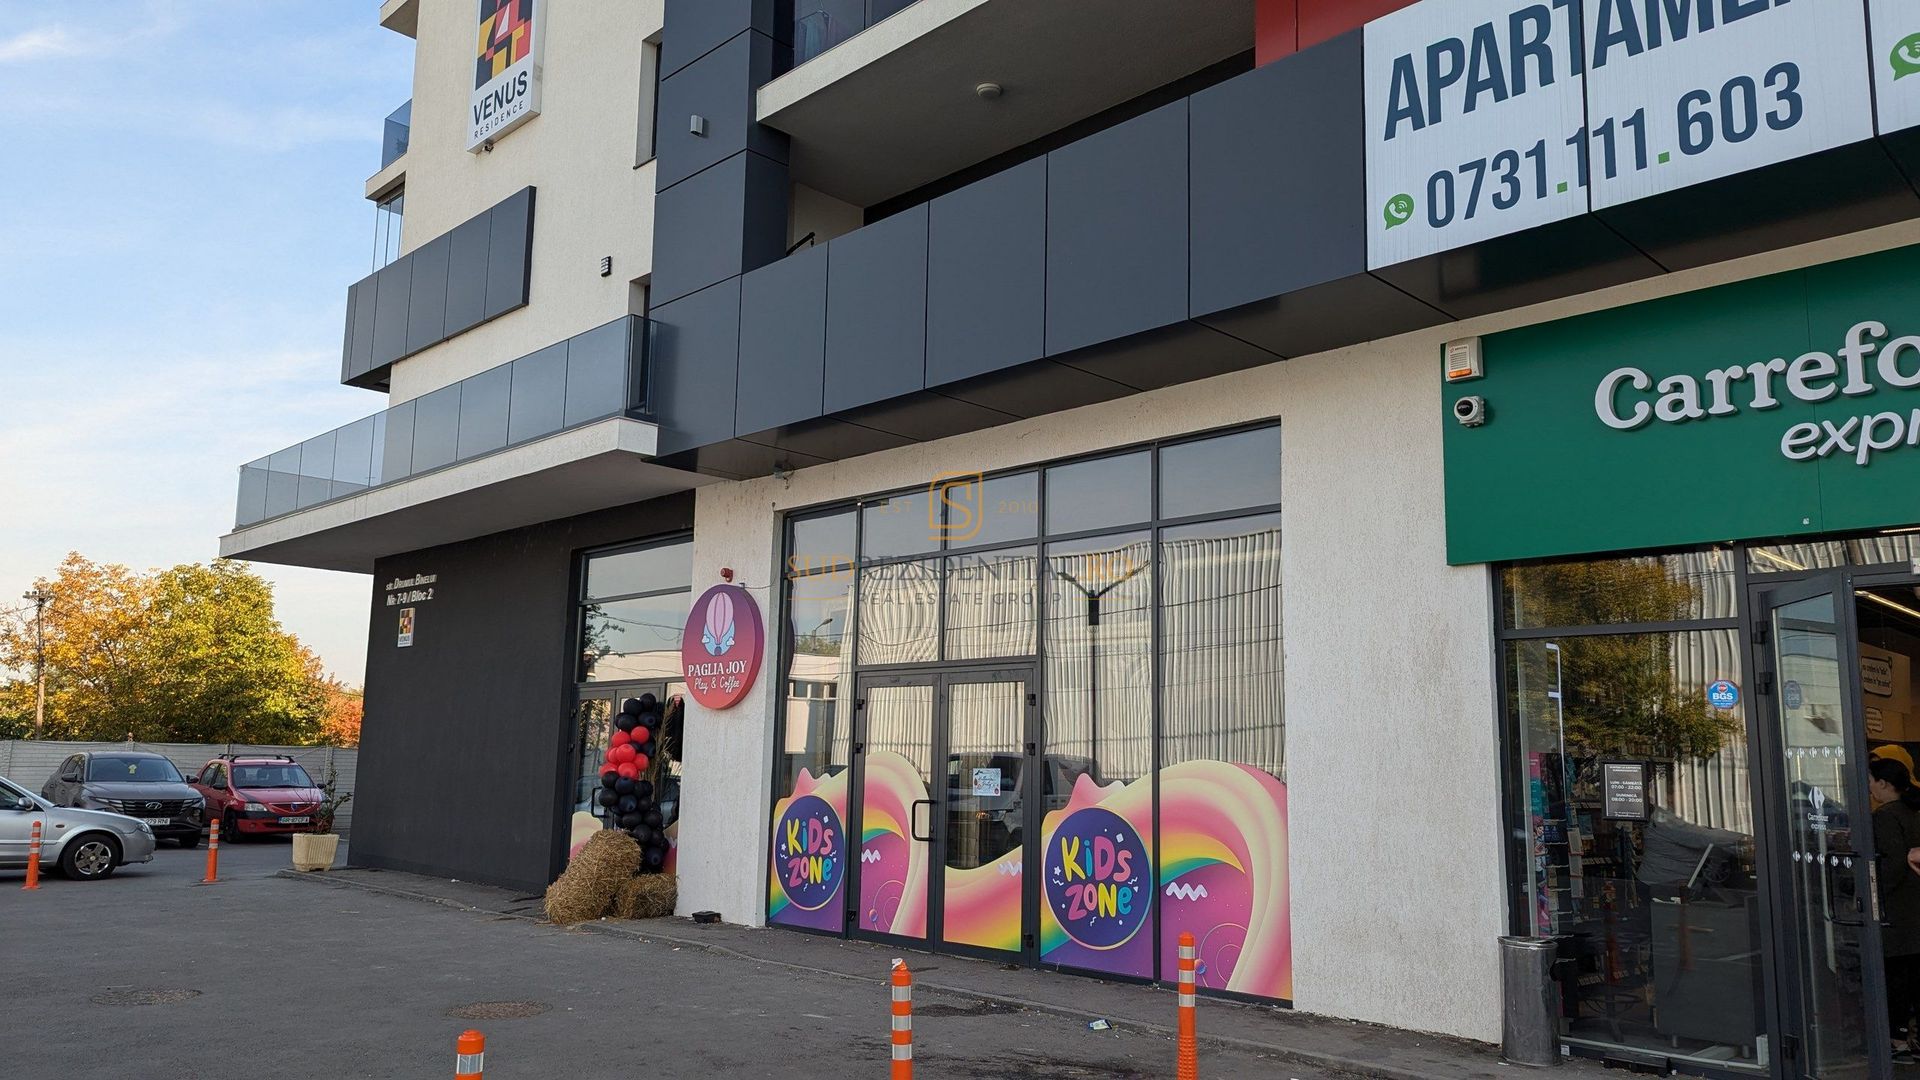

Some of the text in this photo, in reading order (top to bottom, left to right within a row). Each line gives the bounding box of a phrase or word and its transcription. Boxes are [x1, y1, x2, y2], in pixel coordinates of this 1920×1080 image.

[1384, 0, 1791, 141] APARTAM
[473, 70, 528, 126] VENUS
[473, 100, 524, 140] RESIDENCE
[1427, 62, 1803, 228] 0731.111.603
[1594, 320, 1920, 430] Carrefo
[688, 660, 747, 676] PAGLIA JOY
[694, 676, 740, 695] Play & Coffee
[1712, 692, 1733, 700] BGS
